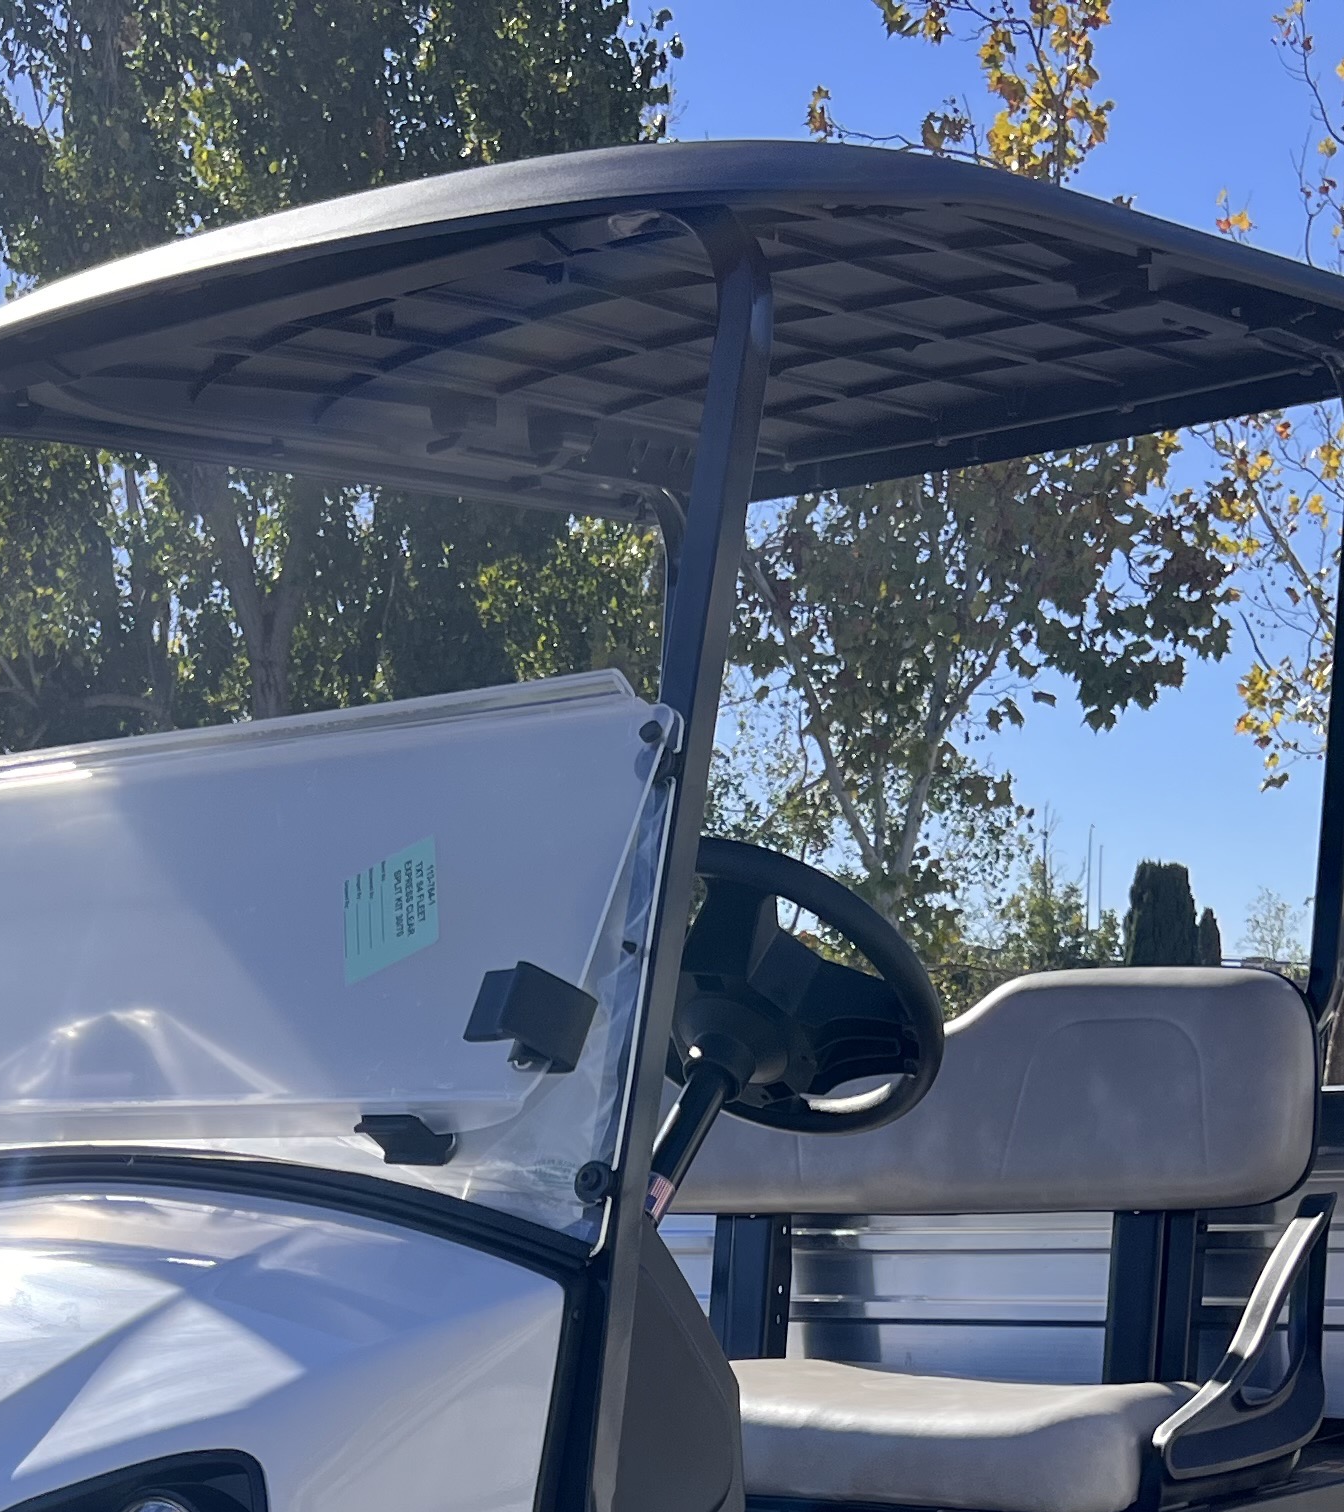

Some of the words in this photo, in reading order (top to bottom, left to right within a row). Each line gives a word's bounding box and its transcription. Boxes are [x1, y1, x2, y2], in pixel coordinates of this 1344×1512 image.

[394, 869, 403, 895] SPLIT
[404, 859, 413, 904] EXPRESS
[395, 896, 403, 912] KIT
[417, 893, 426, 922] FLEET
[406, 904, 416, 937] CLEAR
